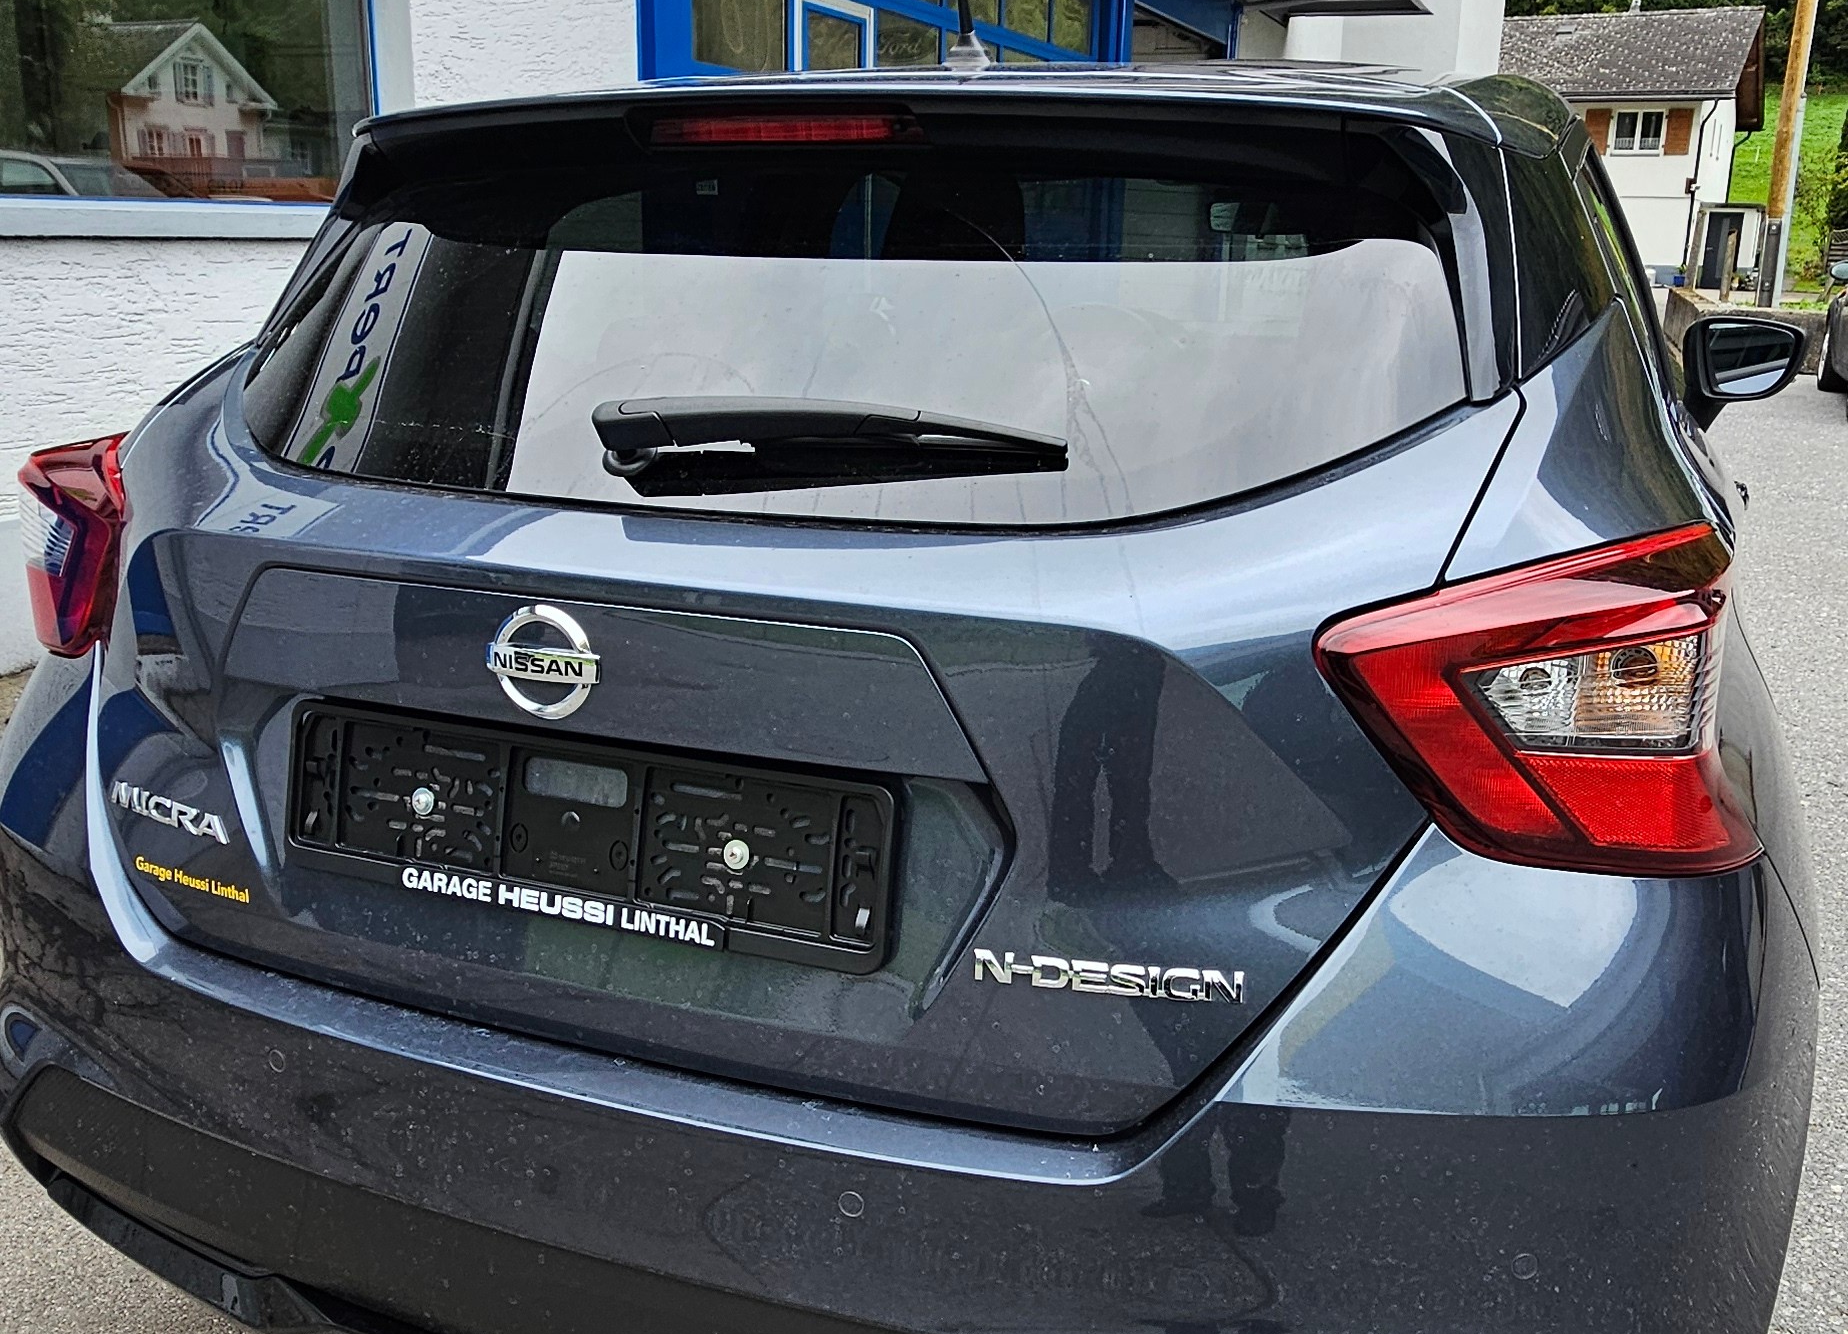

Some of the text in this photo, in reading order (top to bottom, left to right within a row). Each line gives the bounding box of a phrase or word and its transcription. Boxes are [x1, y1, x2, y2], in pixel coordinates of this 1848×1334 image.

[493, 651, 583, 678] NISSAN
[111, 780, 230, 845] MICRA
[135, 856, 250, 904] Garage Heussi Linthal
[401, 867, 716, 948] GARAGE HEUSSI LINTHAL
[973, 948, 1246, 1004] N-DESIGN
